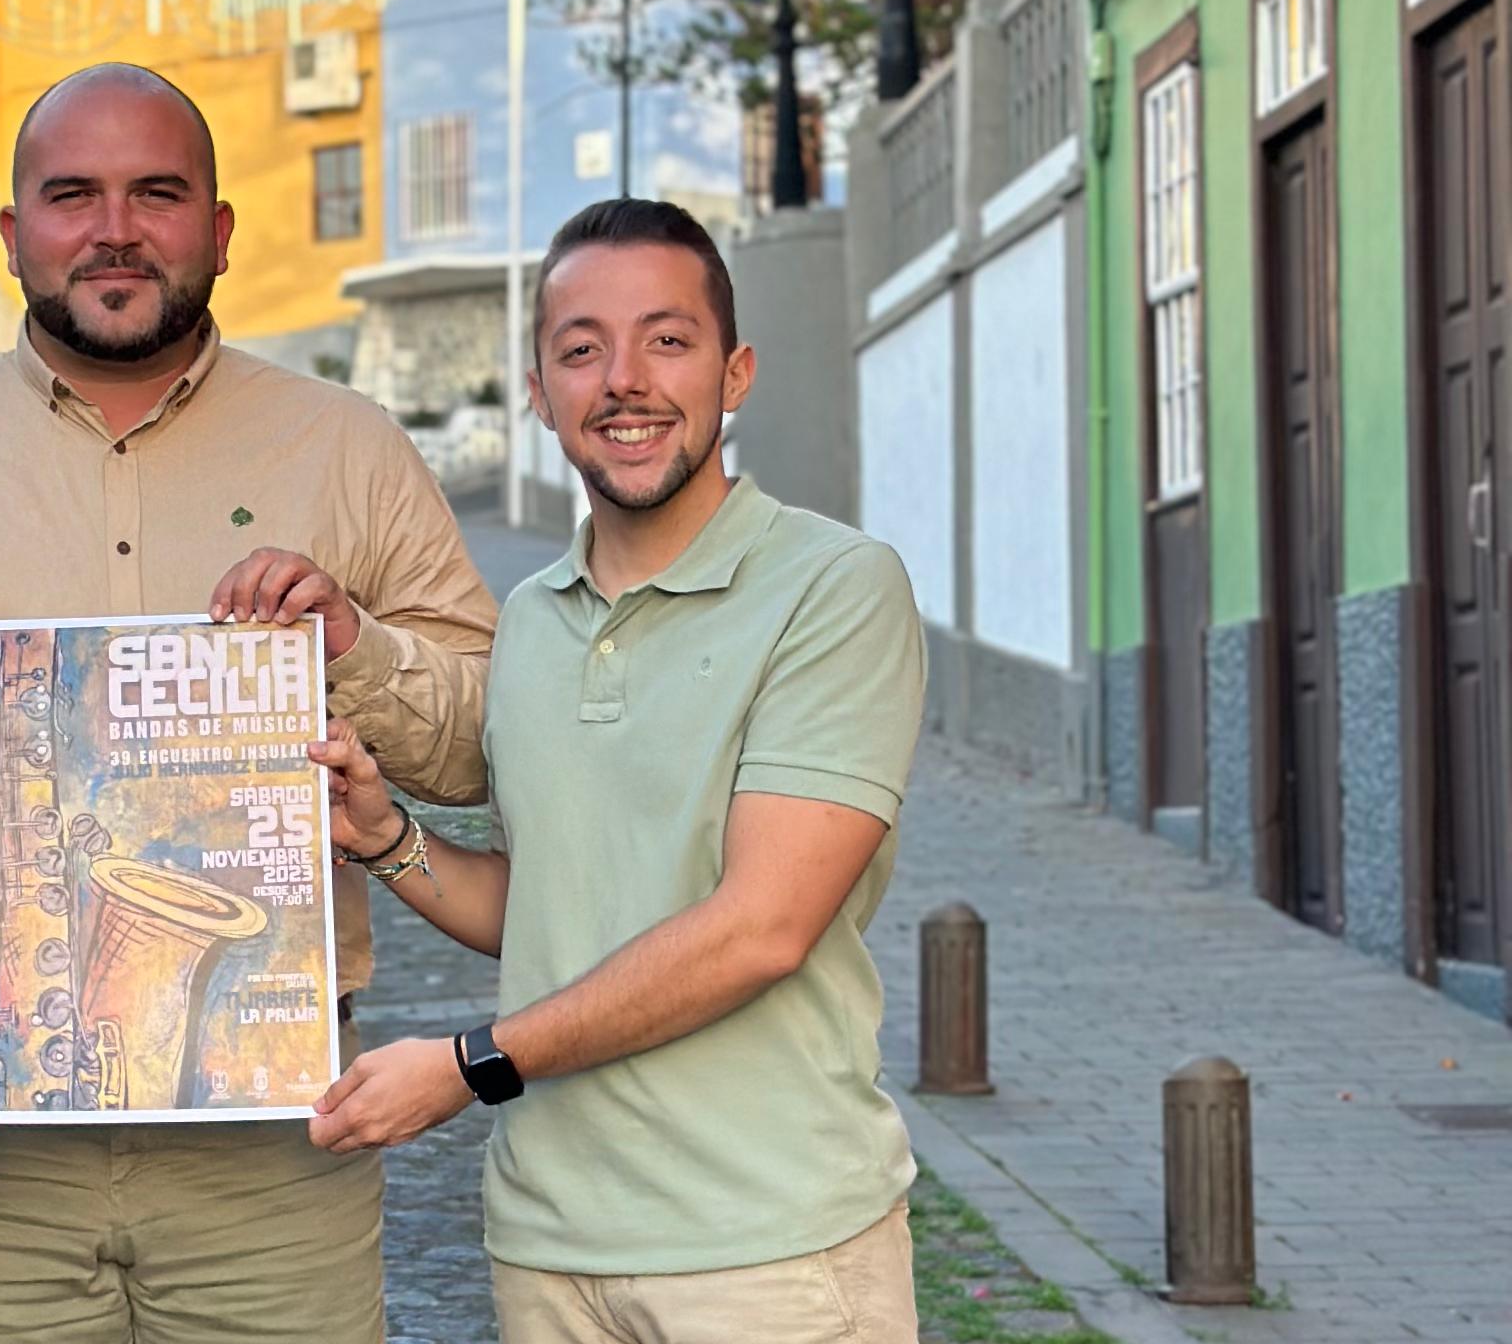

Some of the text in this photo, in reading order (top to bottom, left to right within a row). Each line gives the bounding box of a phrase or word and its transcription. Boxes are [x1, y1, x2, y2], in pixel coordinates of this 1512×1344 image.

[108, 629, 309, 677] SANTA
[108, 665, 311, 718] CECILIA
[108, 714, 311, 740] BANDAS DE MÚSICA
[110, 750, 131, 766] 39
[139, 746, 233, 765] ENCUENTRO
[248, 804, 313, 848] 25
[202, 847, 313, 868] NOVIEMBRE
[263, 865, 313, 883] 2023
[253, 884, 313, 896] DESDE LAS
[272, 895, 302, 906] 17:00
[240, 1007, 319, 1024] LA PALMA
